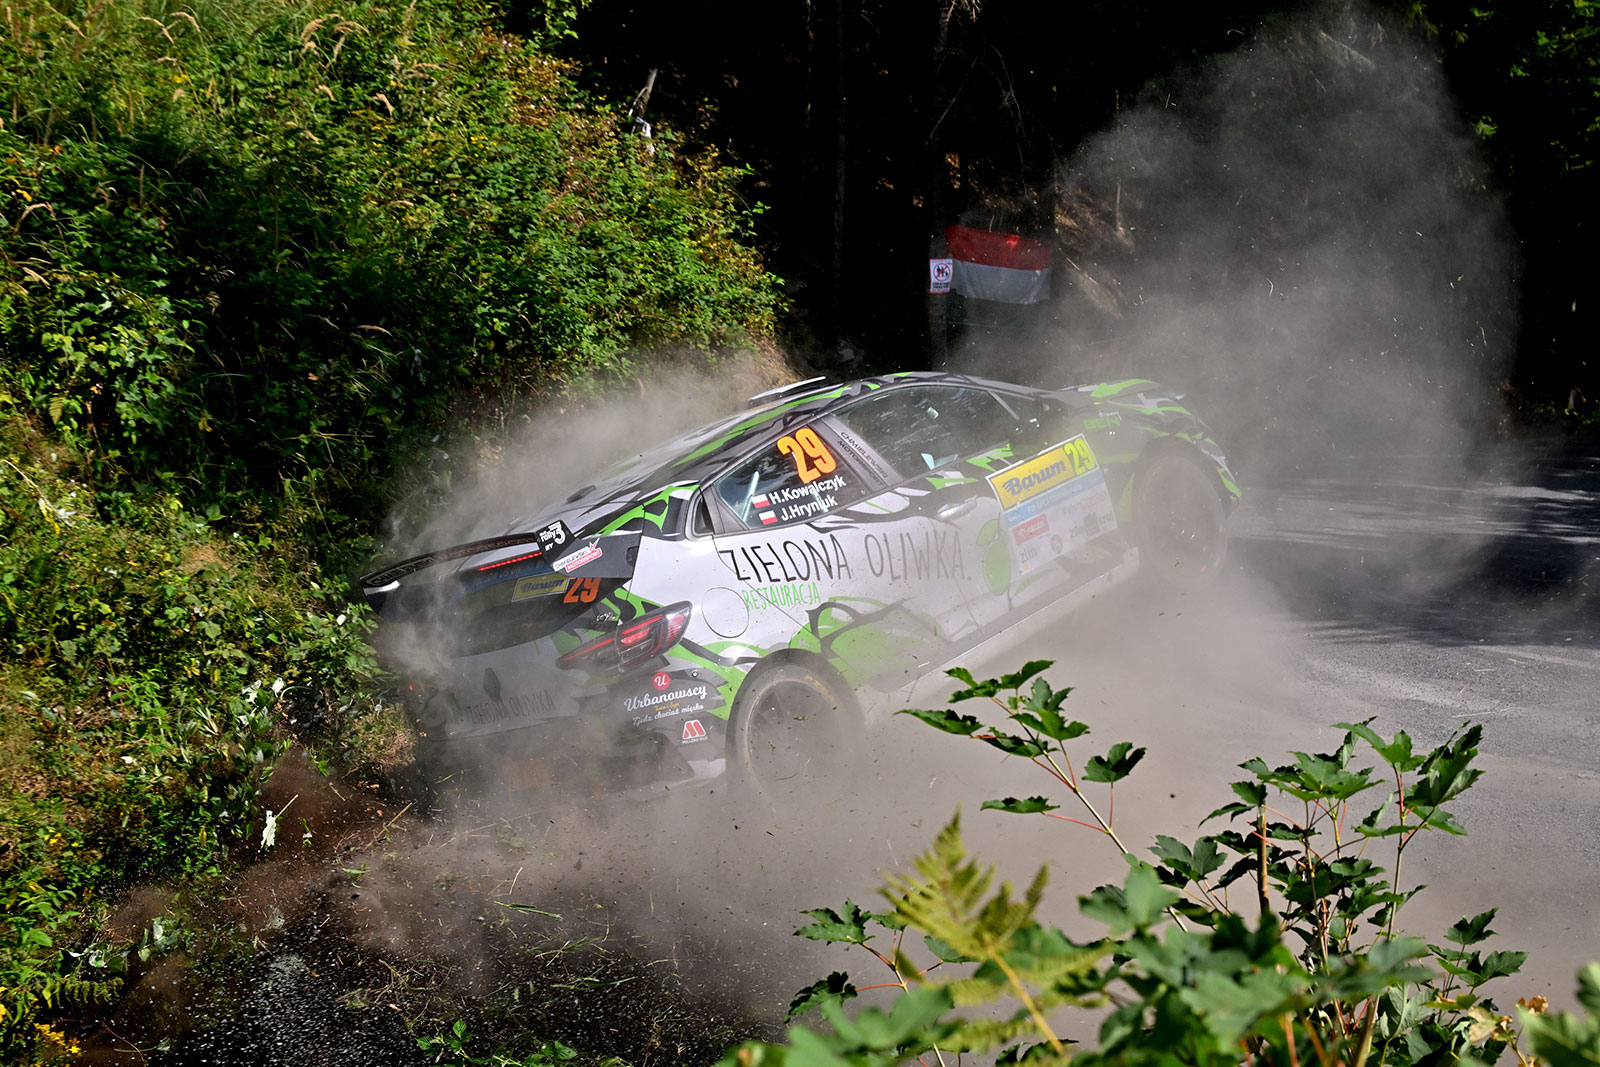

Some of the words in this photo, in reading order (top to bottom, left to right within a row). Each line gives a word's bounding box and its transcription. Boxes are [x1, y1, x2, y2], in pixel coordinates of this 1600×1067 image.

[777, 427, 837, 484] 29
[837, 440, 882, 487] MOTORSPORT
[840, 431, 889, 479] CHMIELEWSKI
[1002, 460, 1067, 497] Barum
[1063, 437, 1096, 476] 29
[768, 475, 847, 505] H.Kowalczyk
[780, 494, 838, 521] J.Hryniuk
[718, 533, 852, 583] ZIELONA
[520, 578, 565, 594] Barum
[563, 577, 601, 604] 29
[741, 580, 822, 612] RESTAURACJA
[654, 675, 668, 687] U
[623, 685, 708, 712] Urbanowscy
